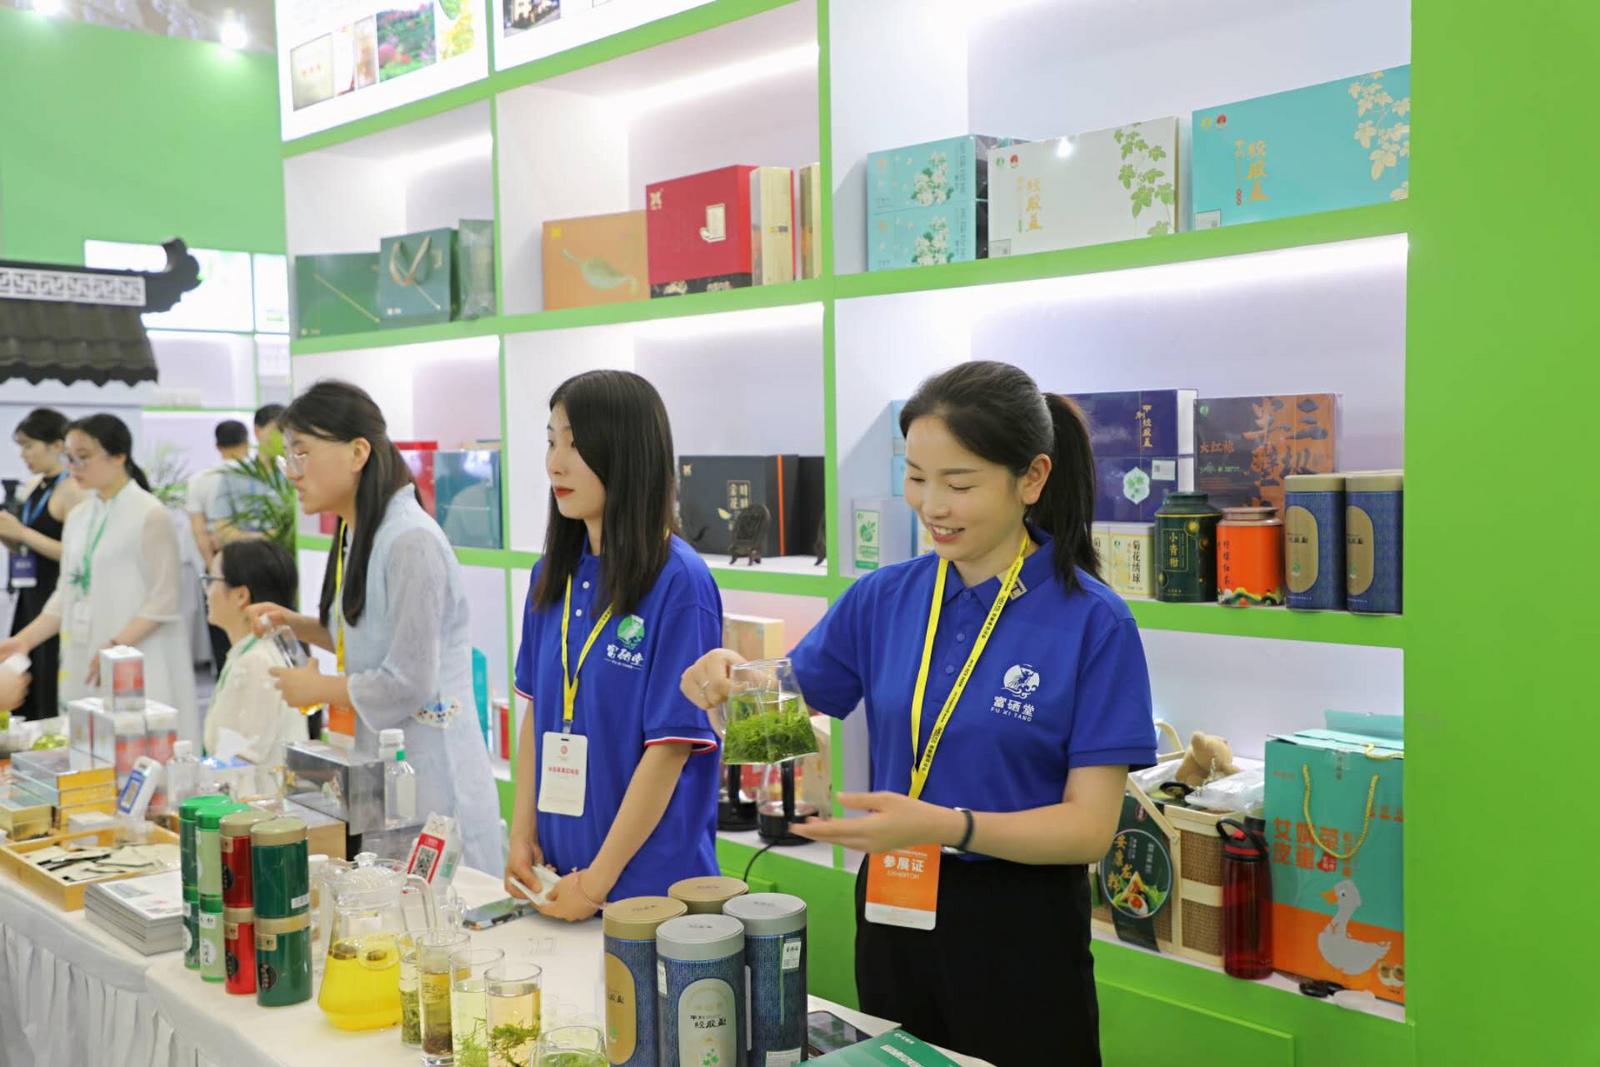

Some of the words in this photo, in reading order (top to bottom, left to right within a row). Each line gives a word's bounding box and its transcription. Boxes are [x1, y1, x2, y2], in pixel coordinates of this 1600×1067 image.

[993, 696, 1034, 717] 富硒堂
[1014, 713, 1032, 722] TANG
[883, 855, 925, 873] 参展证
